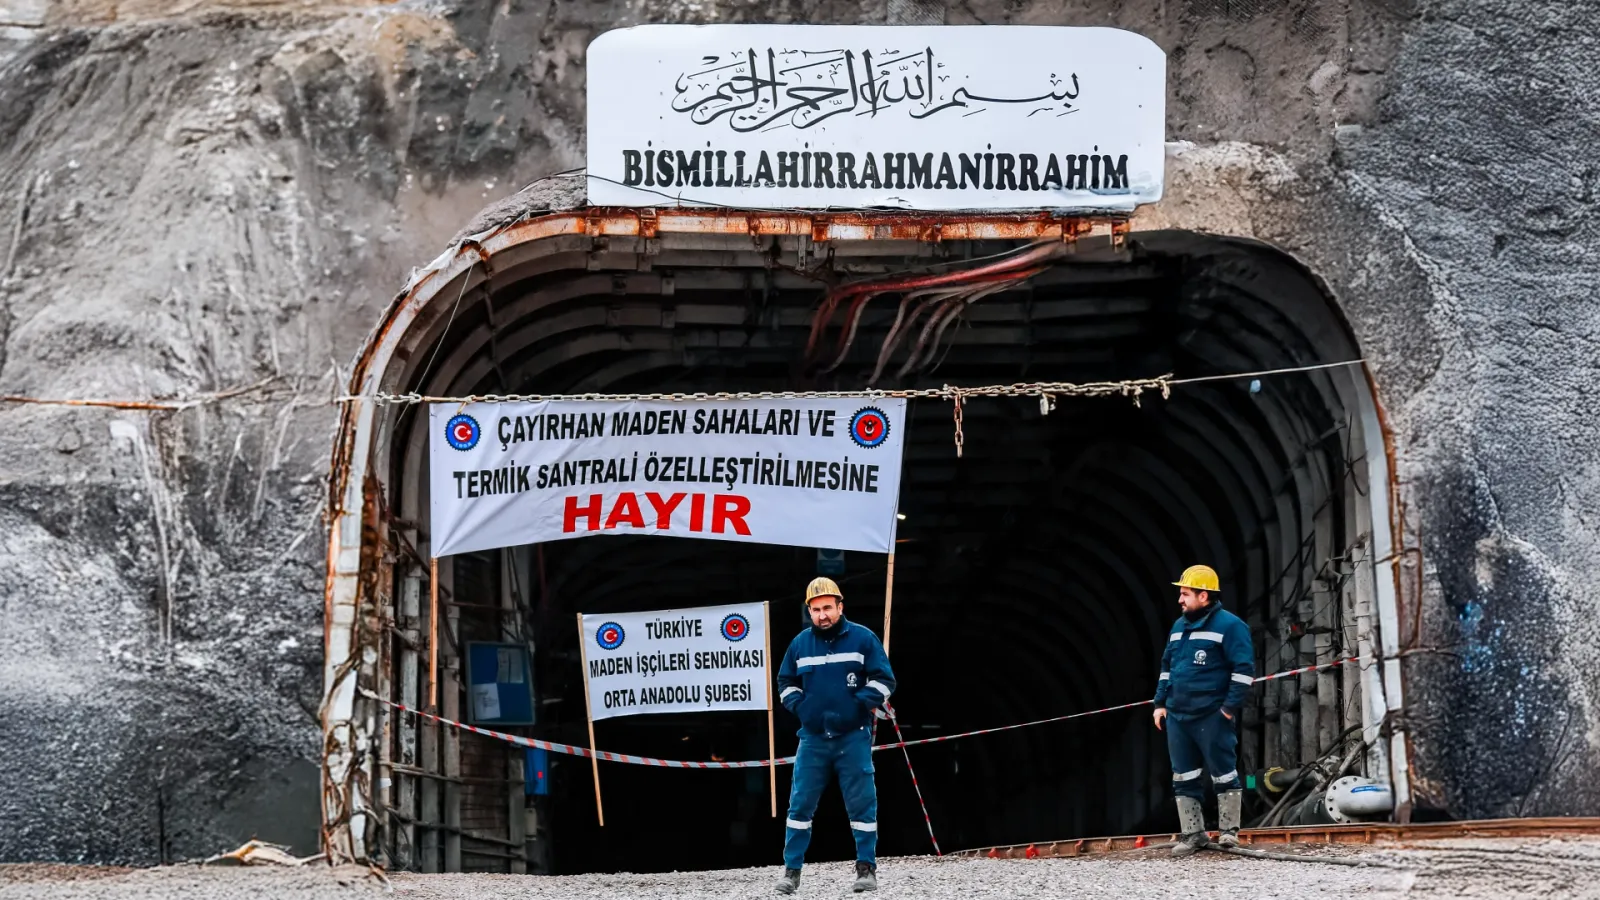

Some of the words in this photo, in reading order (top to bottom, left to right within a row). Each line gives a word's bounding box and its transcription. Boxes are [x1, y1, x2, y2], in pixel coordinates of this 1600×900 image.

[622, 141, 1129, 191] BİSMİLLAHİRRAHMANİRRAHİM
[498, 413, 605, 452] ÇAYIRHAN
[611, 410, 687, 437] MADEN
[693, 408, 800, 436] SAHALARI
[808, 409, 836, 438] VE
[453, 461, 530, 499] TERMİK
[537, 451, 638, 490] SANTRALİ
[644, 452, 879, 493] ÖZELLEŞTİRİLMESİNE
[563, 492, 752, 536] HAYIR
[645, 616, 703, 640] TÜRKİYE
[589, 656, 633, 679] MADEN
[636, 648, 690, 677] İŞÇİLERİ
[694, 646, 764, 669] SENDİKASI
[603, 688, 637, 708] ORTA
[639, 685, 700, 705] ANADOLU
[704, 679, 752, 707] ŞUBESİ
